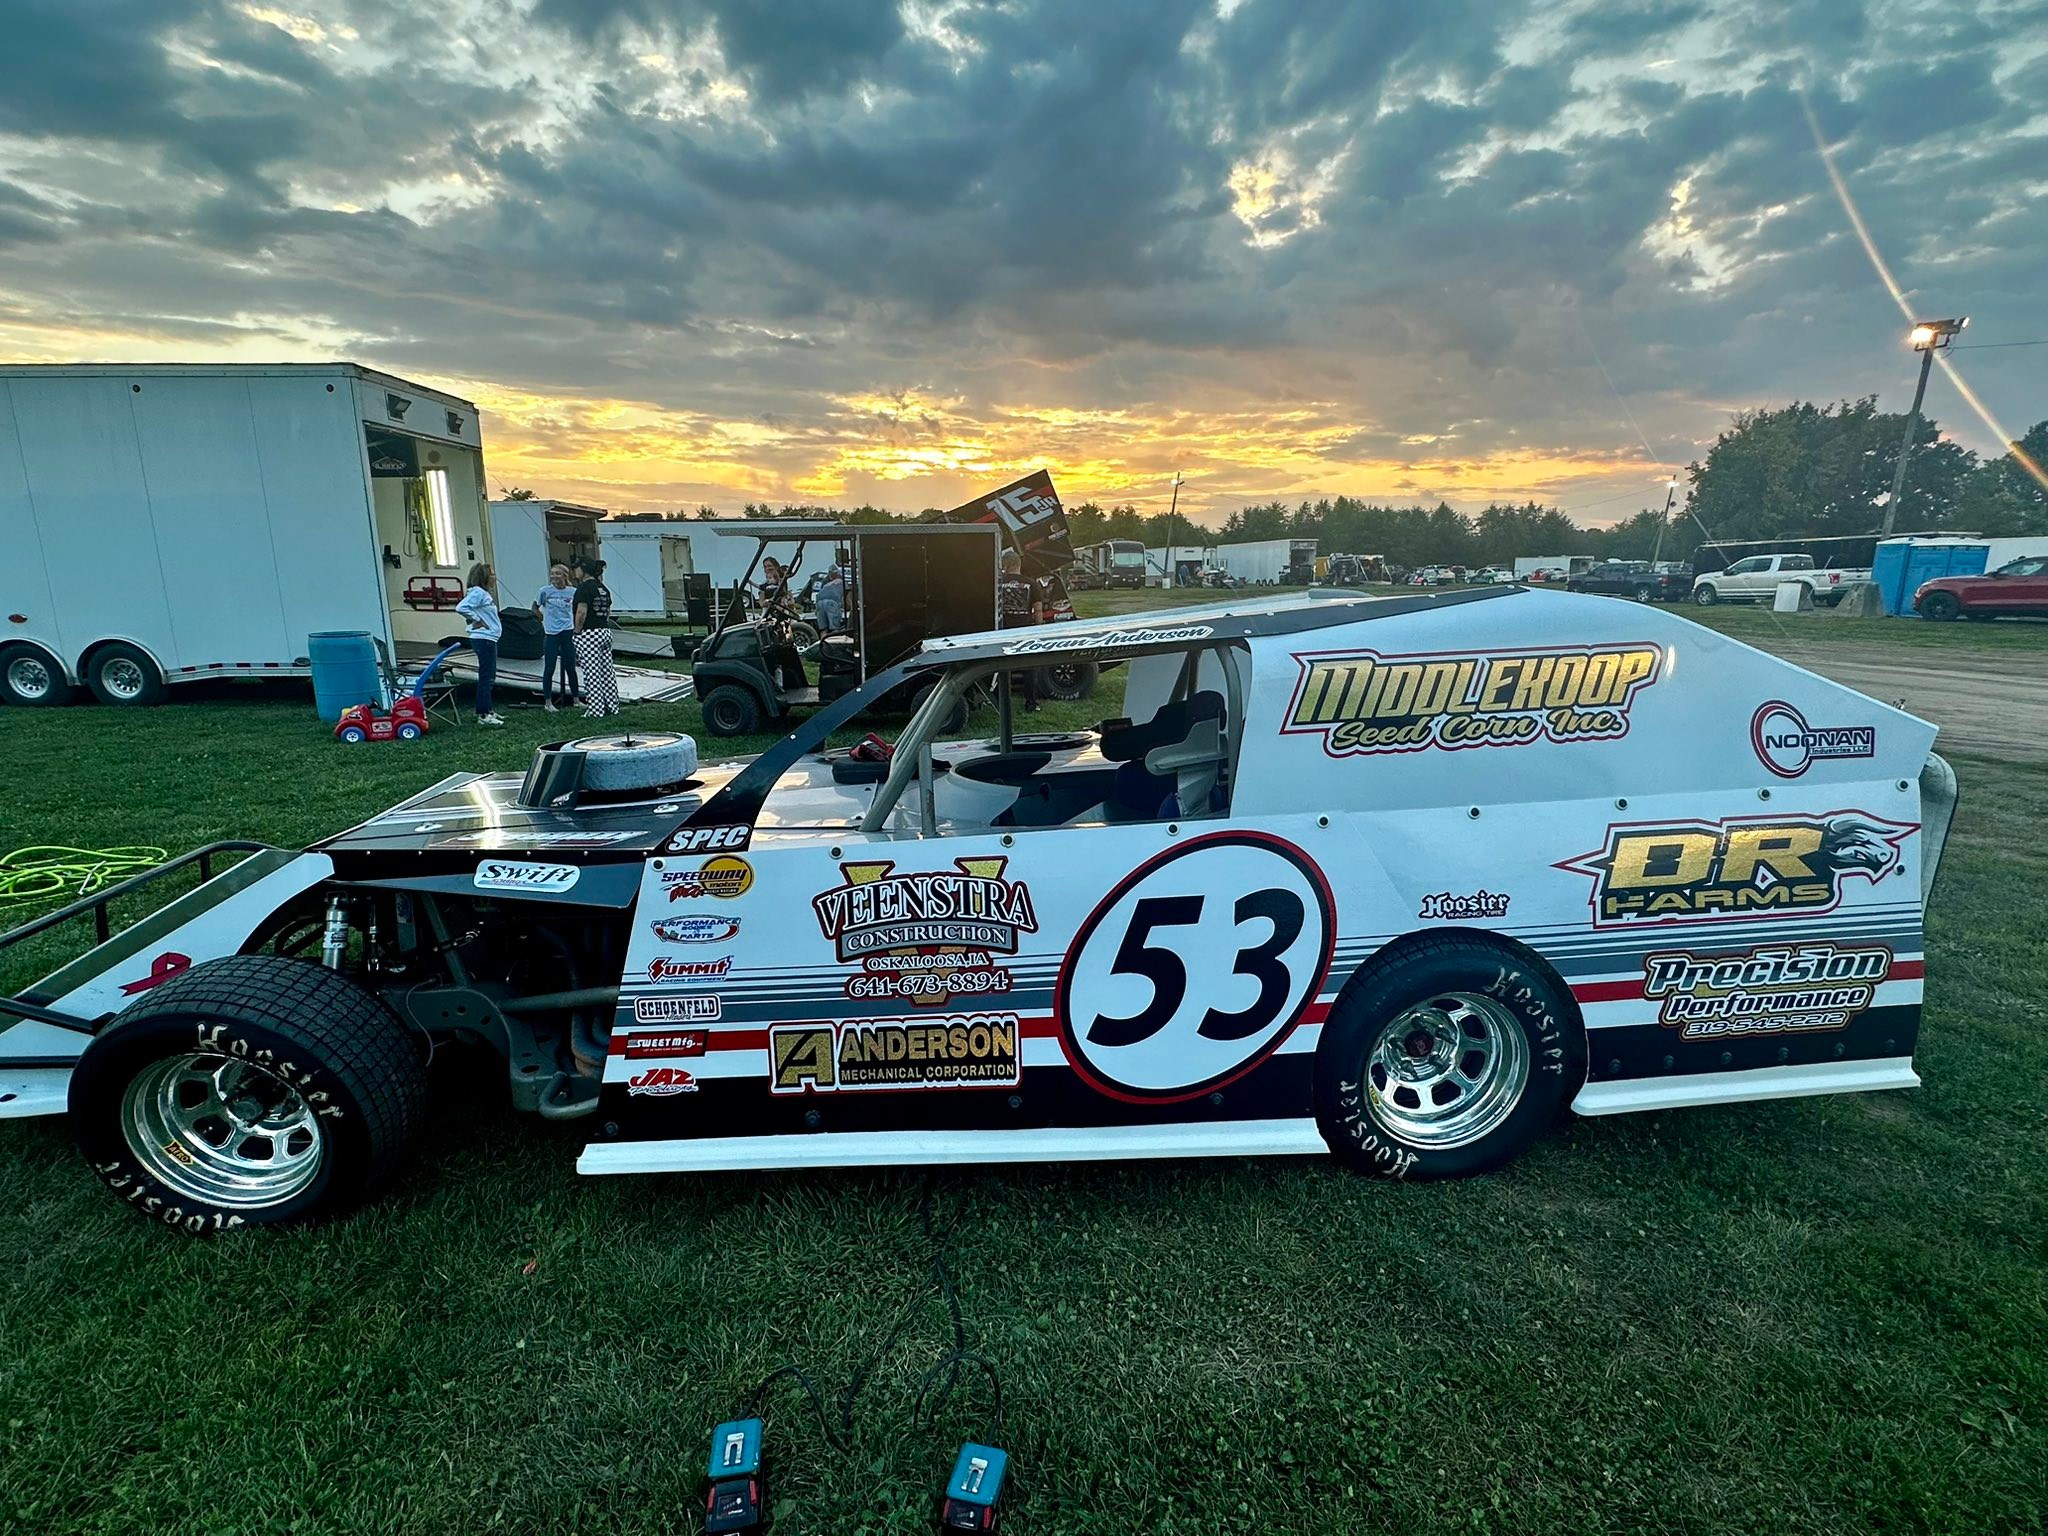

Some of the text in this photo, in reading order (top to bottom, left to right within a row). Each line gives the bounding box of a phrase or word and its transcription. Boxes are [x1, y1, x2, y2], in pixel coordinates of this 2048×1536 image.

[986, 486, 1055, 532] 15
[1011, 637, 1089, 653] Logan
[1089, 627, 1208, 648] Anderson
[1296, 651, 1654, 722] MIDDLEKOOP
[1333, 707, 1622, 747] Seed Corn Inc.
[1765, 731, 1871, 749] NOONAN
[668, 826, 750, 851] SPEC
[661, 869, 748, 882] SPEEDWAY
[817, 876, 1035, 937] VEENSTRA
[1419, 890, 1510, 918] Hoosier
[1447, 910, 1482, 918] RACING
[653, 918, 738, 927] PERFORMANCE
[680, 932, 715, 940] PARTS
[847, 925, 1007, 951] CONSTRUCTION
[1086, 888, 1305, 1047] 53
[1648, 950, 1887, 995] Precision
[849, 970, 1009, 997] 641-673-8894
[640, 999, 715, 1016] SCHOENFELD
[1665, 986, 1868, 1021] Performance
[1686, 1012, 1846, 1036] 319-545-2212
[634, 1037, 671, 1048] SWEET
[841, 1025, 1014, 1063] ANDERSON
[629, 1067, 695, 1087] JAZ
[841, 1063, 1015, 1082] MECHANICAL CORPORATION
[168, 1145, 189, 1162] AERO
